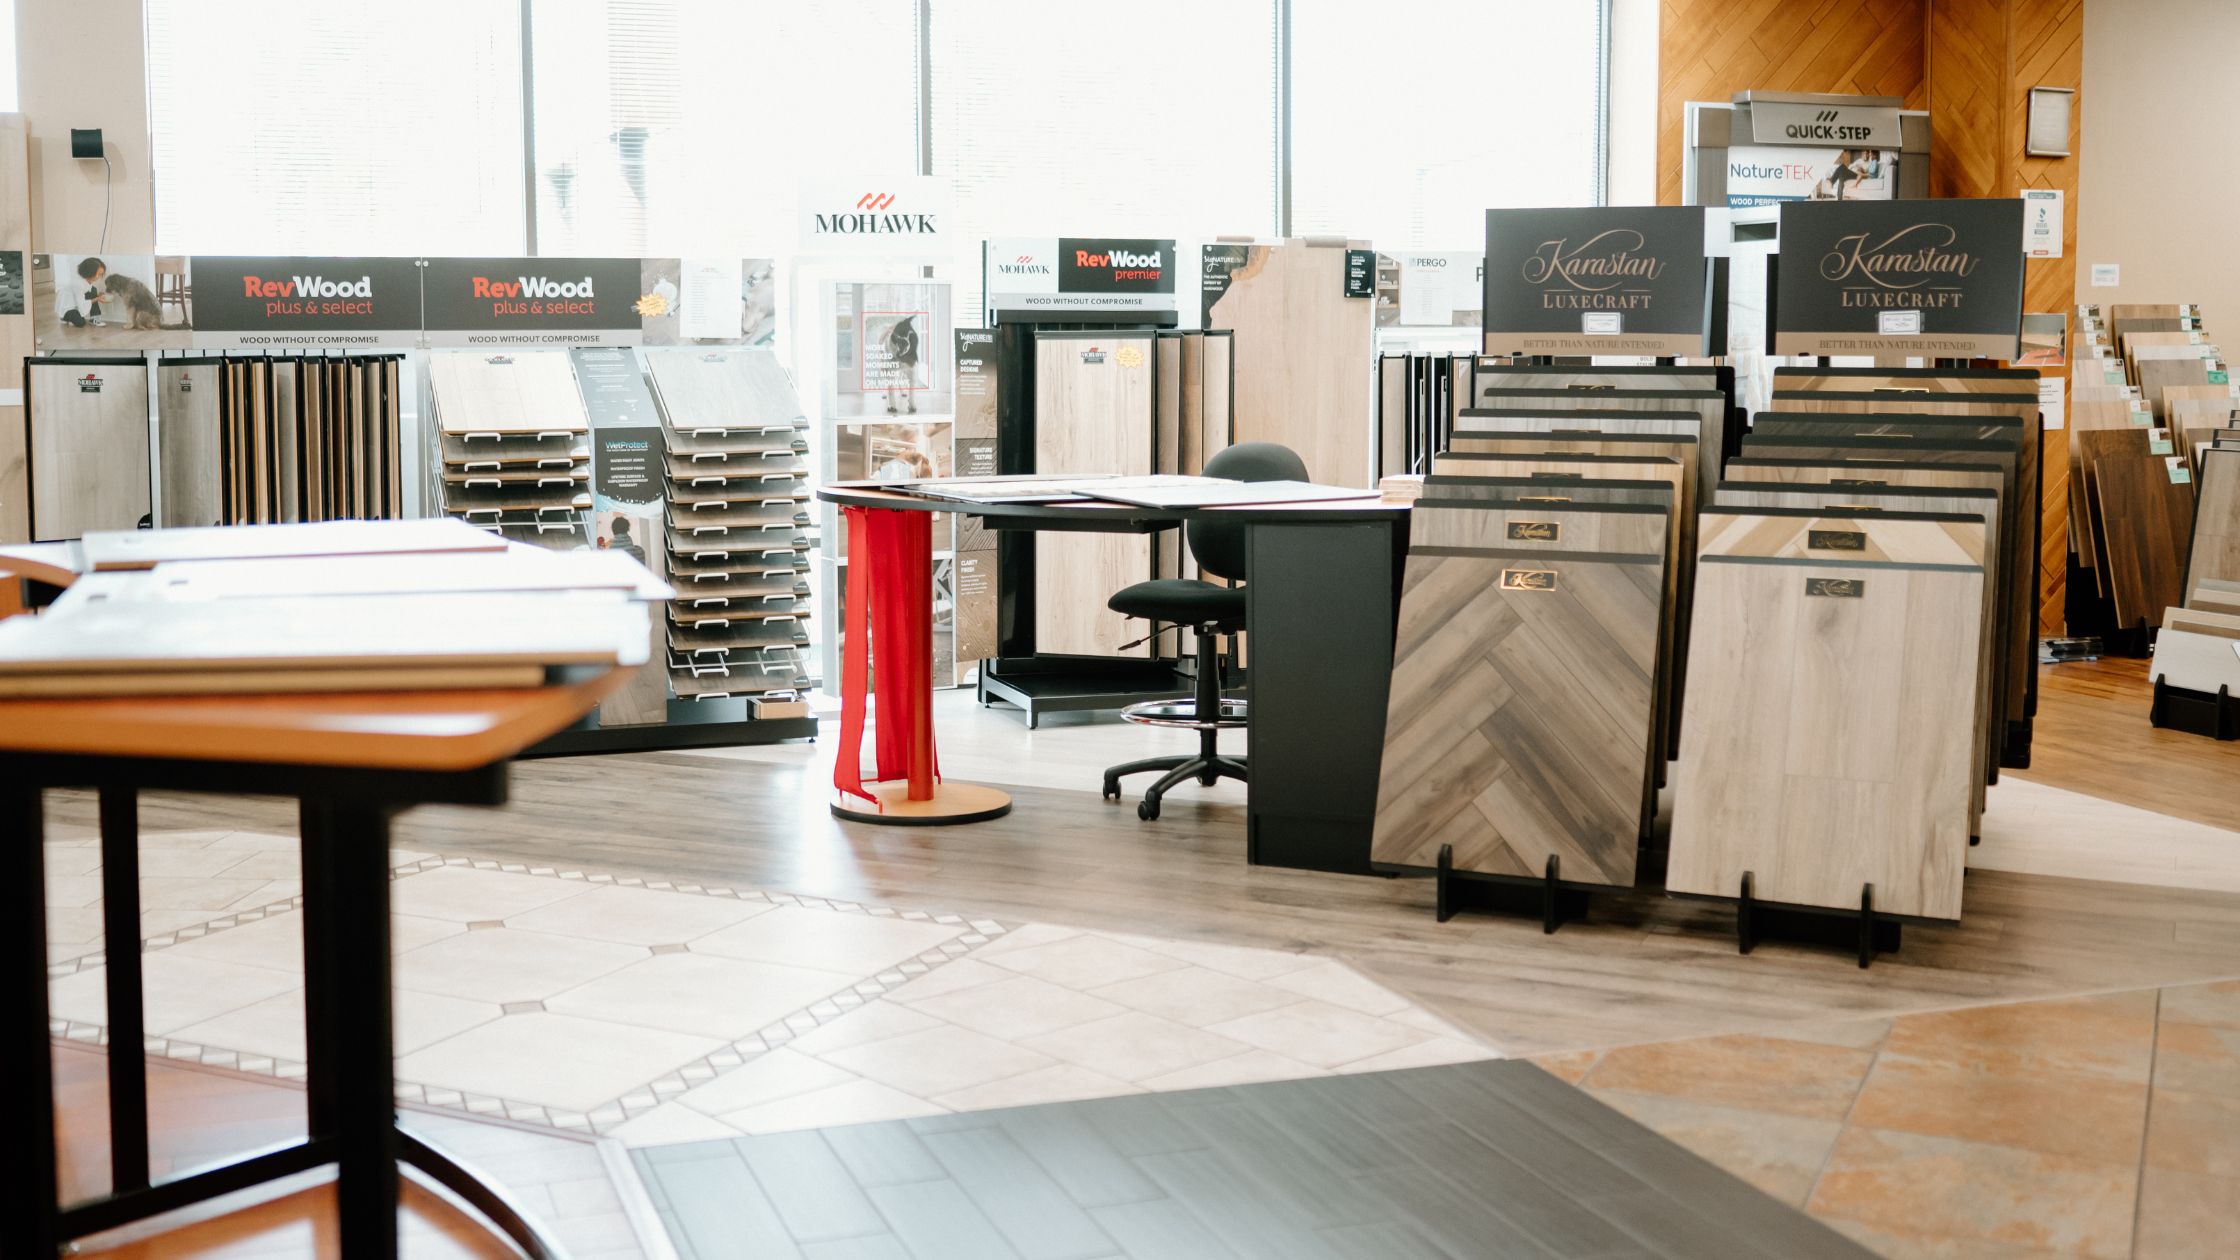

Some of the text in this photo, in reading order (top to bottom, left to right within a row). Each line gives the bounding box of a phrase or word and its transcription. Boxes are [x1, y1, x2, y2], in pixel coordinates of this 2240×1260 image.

[1730, 163, 1814, 180] NatureTEK
[1730, 197, 1753, 206] WOOD
[814, 213, 937, 234] MOHAWK
[1075, 250, 1162, 268] RevWood
[1416, 258, 1447, 267] PERGO
[1522, 229, 1667, 291] Karastan
[1820, 223, 1981, 289] Karastan
[998, 264, 1050, 274] MOHAWK
[1115, 268, 1162, 282] premier
[243, 276, 373, 298] RevWood
[472, 276, 594, 298] RevWood
[1025, 297, 1143, 305] WOOD WITHOUT COMPROMISE
[1543, 294, 1652, 309] LUXECRAFT
[1841, 291, 1963, 308] LUXECRAFT
[266, 300, 373, 318] plus & select
[493, 300, 595, 318] plus & select
[239, 335, 379, 345] WOOD WITHOUT COMPROMISE
[468, 334, 601, 344] WOOD WITHOUT COMPROMISE
[1523, 339, 1665, 350] BETTER THAN NATURE INTENDED
[1819, 339, 1976, 351] BETTER THAN NATURE INTENDED
[865, 361, 900, 369] MOMENTS
[605, 440, 649, 449] WetProtect
